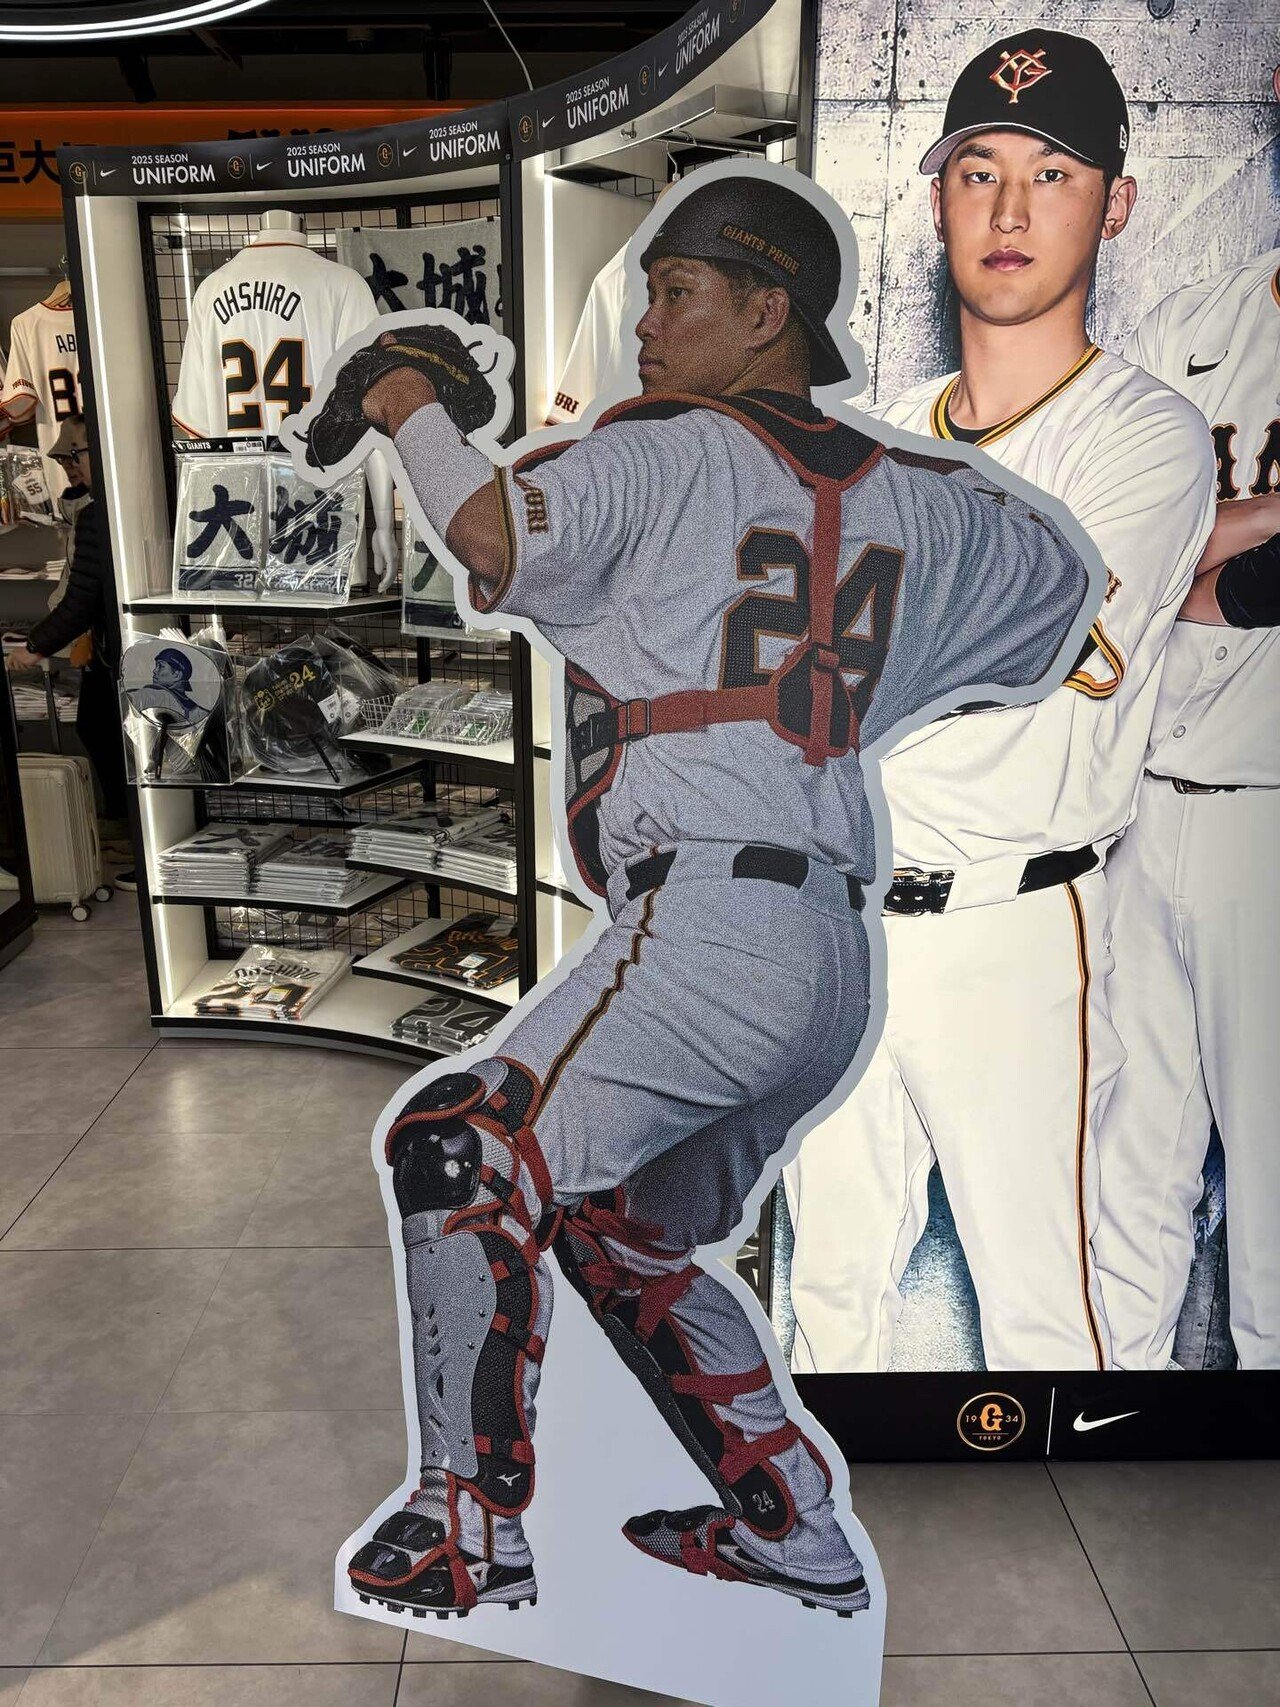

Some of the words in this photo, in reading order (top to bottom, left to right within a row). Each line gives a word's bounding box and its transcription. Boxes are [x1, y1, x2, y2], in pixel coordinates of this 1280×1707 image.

[675, 13, 720, 75] UNIFORM
[565, 90, 582, 104] 2025
[583, 76, 610, 97] SEASON
[566, 84, 629, 129] UNIFORM
[429, 128, 447, 139] 2025
[448, 121, 478, 137] SEASON
[429, 130, 500, 162] UNIFORM
[131, 155, 153, 165] 2025
[154, 153, 189, 164] SEASON
[286, 146, 306, 156] 2025
[308, 143, 341, 154] SEASON
[287, 153, 366, 178] UNIFORM
[132, 164, 216, 185] UNIFORM
[723, 225, 766, 251] GIANTS
[768, 246, 799, 276] PRIDE
[364, 245, 502, 325] 大城
[213, 281, 302, 325] OHSHIRO
[48, 368, 84, 422] 8
[221, 337, 314, 431] 24
[187, 484, 255, 560] 大
[718, 525, 905, 720] 24
[289, 664, 317, 690] 24
[965, 1414, 977, 1423] 19
[1005, 1414, 1019, 1423] 34
[752, 1490, 775, 1513] 24
